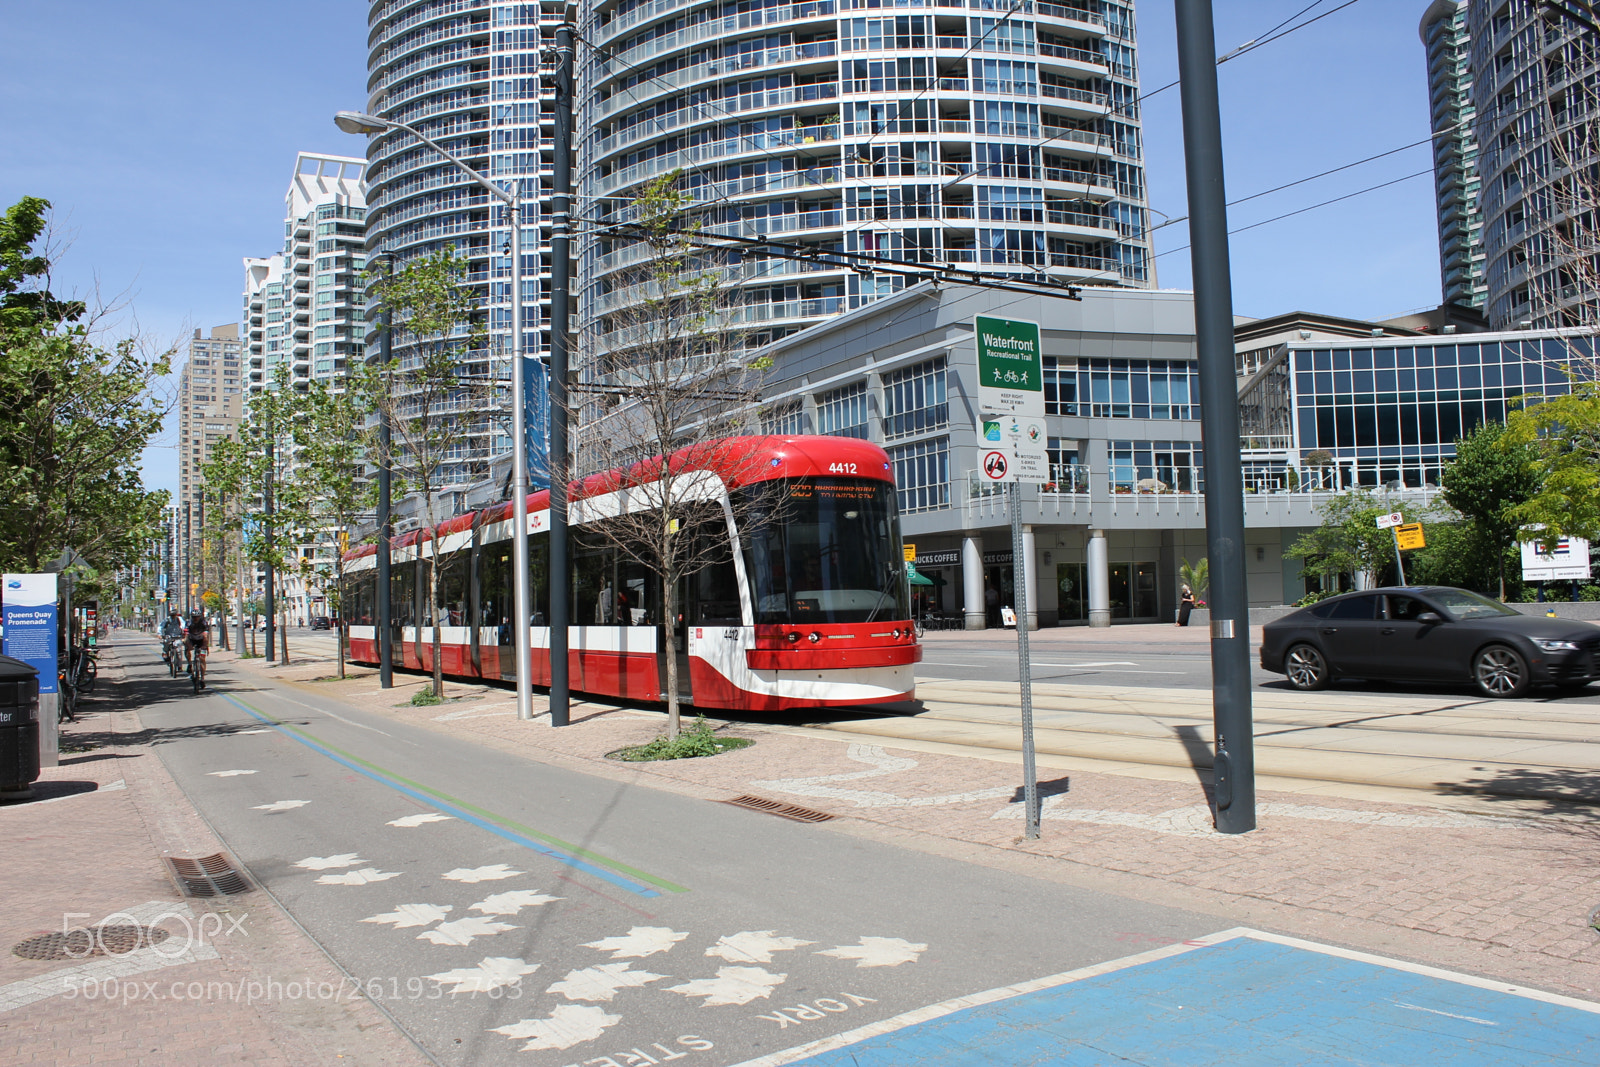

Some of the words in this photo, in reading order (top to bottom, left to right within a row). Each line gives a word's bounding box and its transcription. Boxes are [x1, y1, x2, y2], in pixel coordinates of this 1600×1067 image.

[982, 332, 1034, 351] Waterfront
[986, 348, 1020, 360] Recreational
[1020, 353, 1032, 362] Trail
[828, 462, 858, 475] 4412
[934, 553, 958, 563] COFFEE
[34, 611, 52, 619] Quay
[8, 618, 47, 626] Promenade
[723, 629, 739, 641] 4412
[755, 992, 878, 1029] YORK
[562, 1034, 714, 1067] STRE
